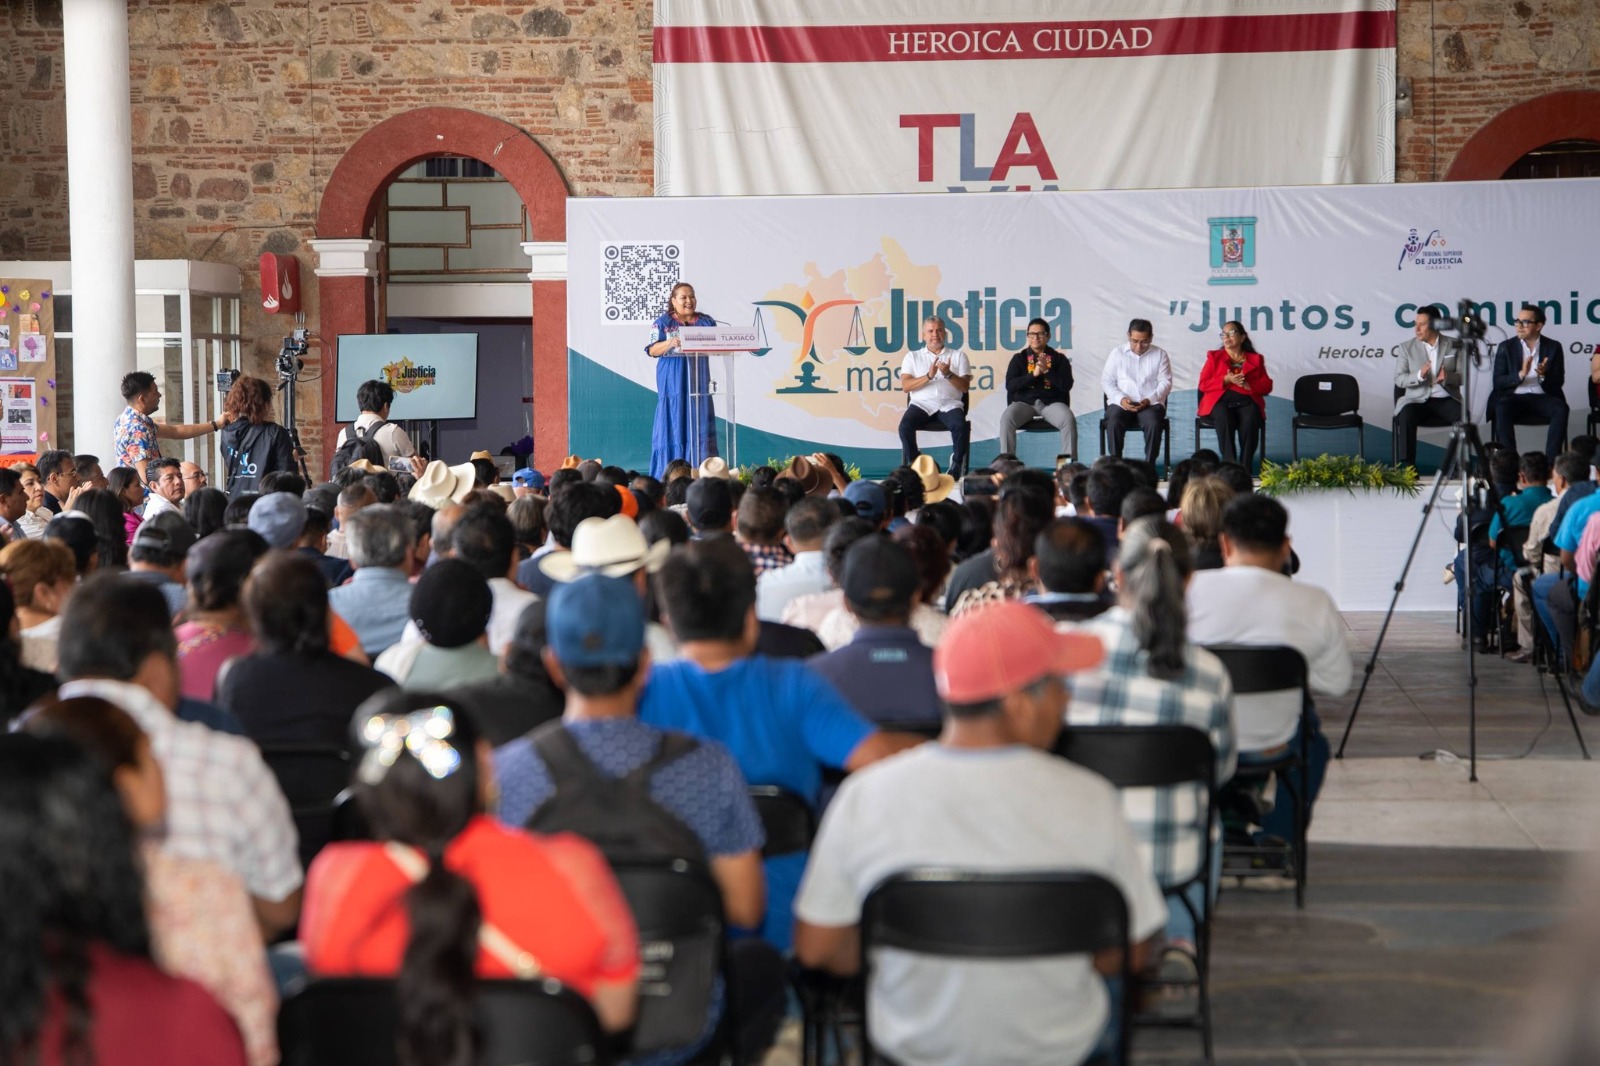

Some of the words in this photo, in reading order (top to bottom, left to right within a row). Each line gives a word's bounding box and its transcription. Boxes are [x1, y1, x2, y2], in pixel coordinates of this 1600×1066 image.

[888, 30, 1023, 54] HEROICA
[1033, 27, 1153, 51] CIUDAD
[899, 112, 1059, 182] TLA
[1428, 257, 1463, 265] JUSTICIA
[874, 286, 1073, 354] Justicia
[1318, 345, 1385, 359] Heroica
[402, 366, 436, 378] Justicia
